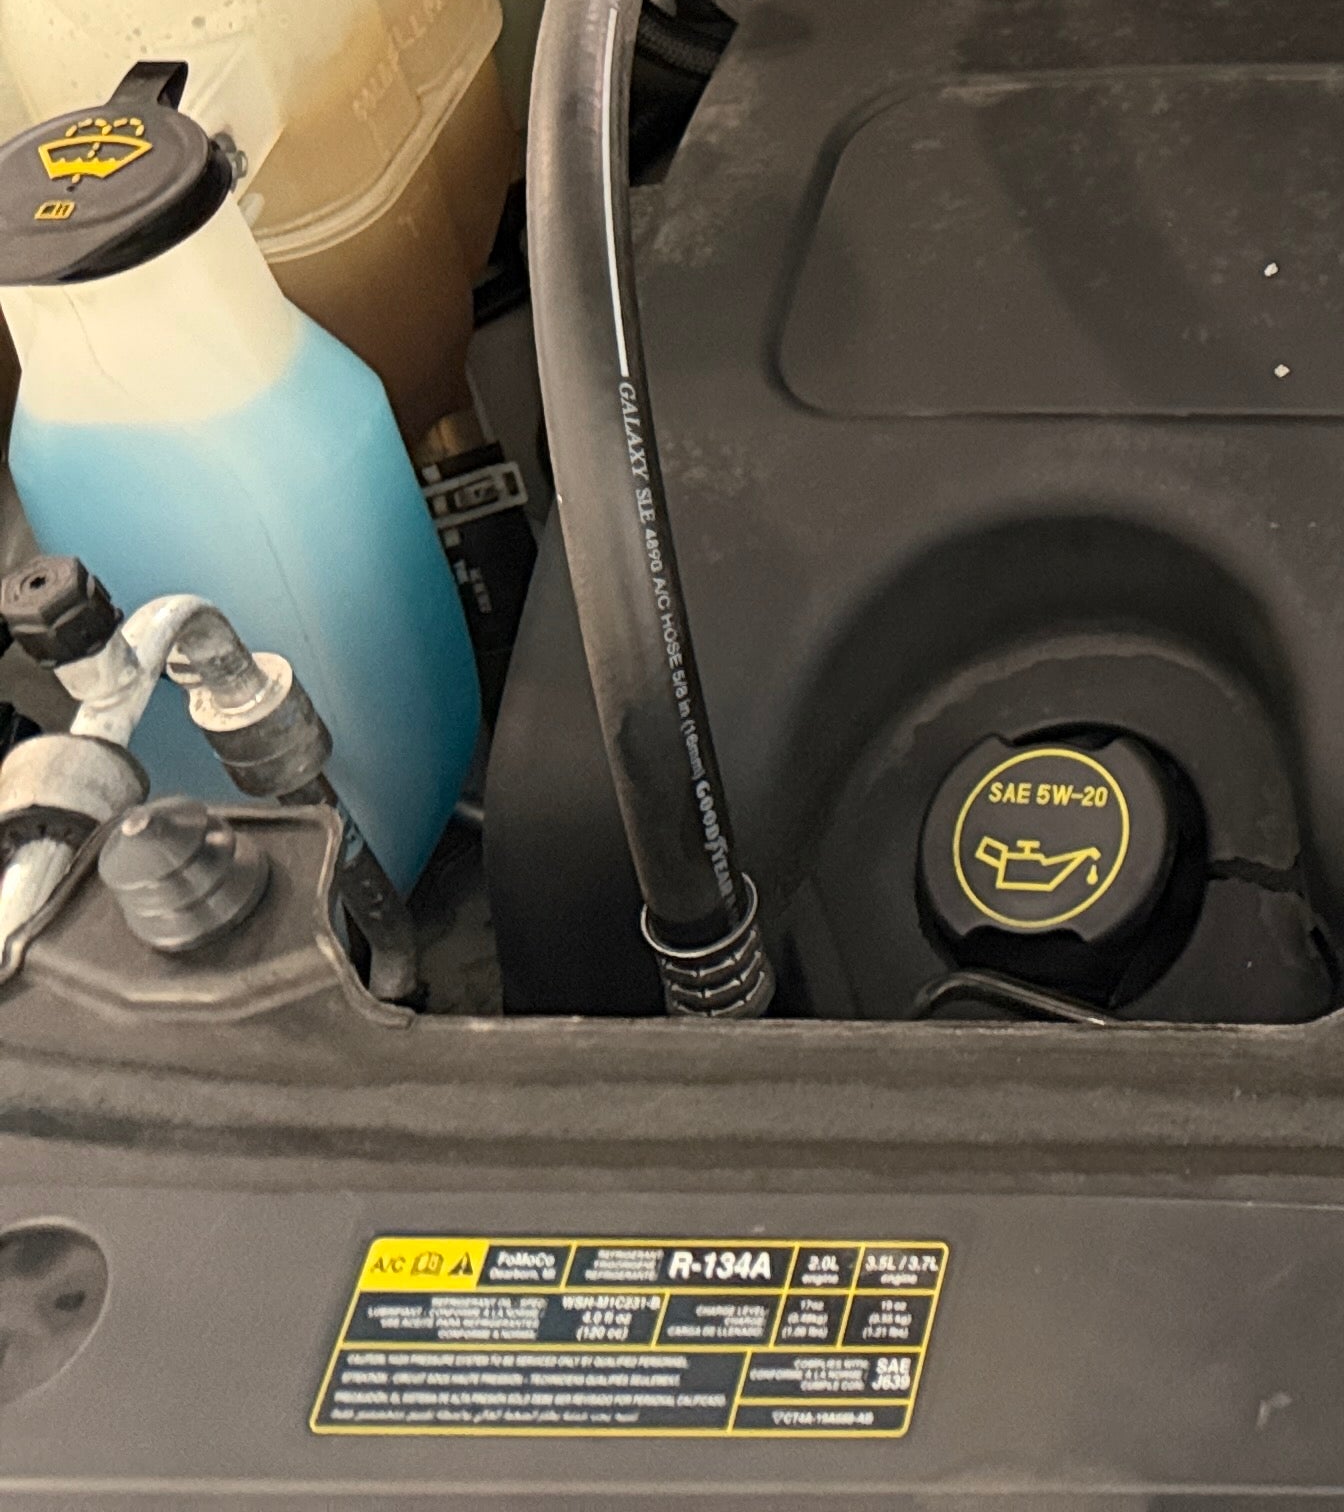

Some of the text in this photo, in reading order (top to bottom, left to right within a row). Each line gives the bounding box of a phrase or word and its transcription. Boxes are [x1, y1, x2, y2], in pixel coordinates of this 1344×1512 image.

[617, 381, 651, 481] GALAXY
[635, 487, 655, 524] SLE
[644, 526, 663, 574] 4890
[652, 576, 671, 611] A/C
[660, 613, 683, 671] HOSE
[671, 670, 689, 700] 5/8
[989, 783, 1109, 808] SAE 5W-20
[695, 781, 734, 897] GOODYEAR
[370, 1256, 406, 1273] A/C
[668, 1251, 771, 1280] R-134A
[807, 1255, 839, 1272] 2.0L
[908, 1256, 939, 1272] 3.7L
[801, 1274, 839, 1286] engine
[880, 1274, 918, 1286] engine
[876, 1358, 911, 1373] SAE
[871, 1374, 911, 1392] J639
